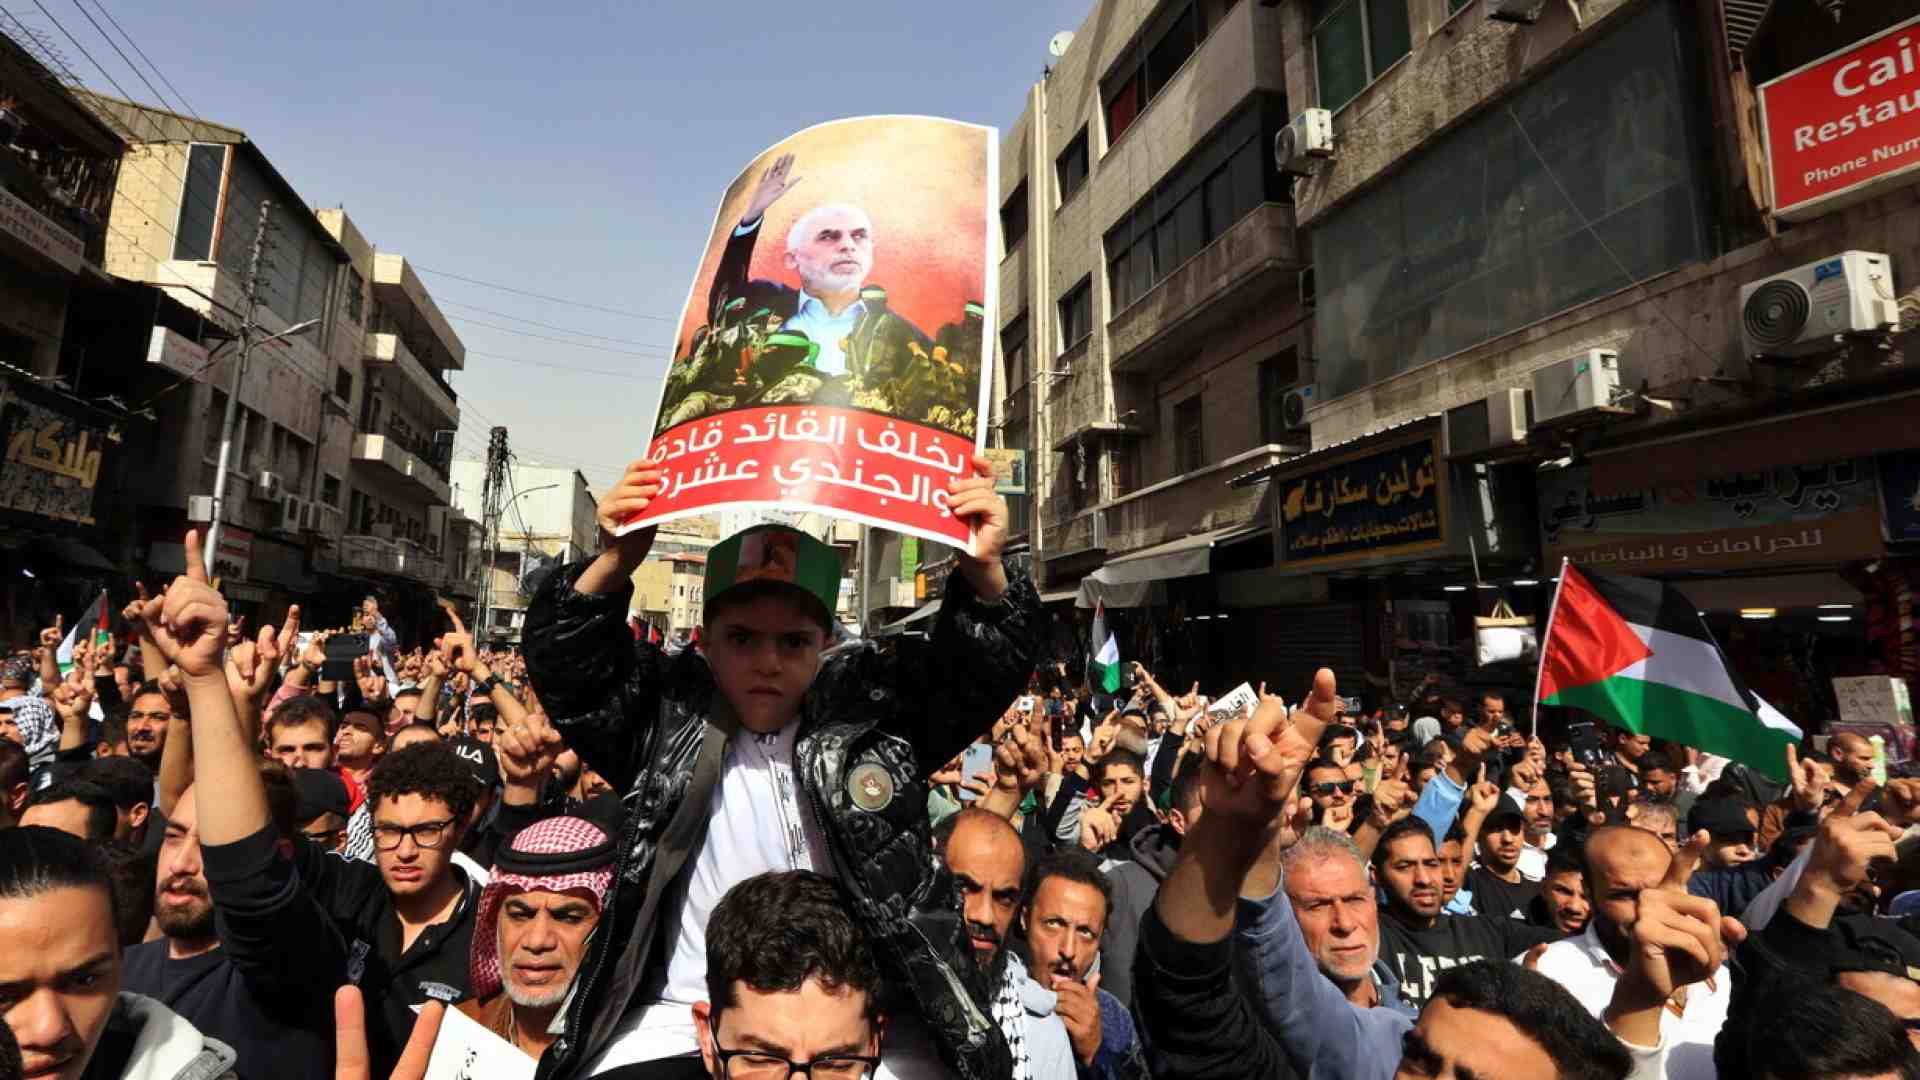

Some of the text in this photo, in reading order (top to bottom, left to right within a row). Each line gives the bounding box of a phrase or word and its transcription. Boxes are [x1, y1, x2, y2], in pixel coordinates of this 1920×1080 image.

[1833, 36, 1920, 97] Cai
[1803, 154, 1868, 187] Phone
[651, 410, 966, 481] يخلف القائد قادة
[772, 456, 953, 518] والجندي
[1303, 454, 1436, 518] تولين سكارف
[1673, 542, 1689, 561] و
[1696, 527, 1824, 557] للحرامات
[456, 744, 484, 764] ILA
